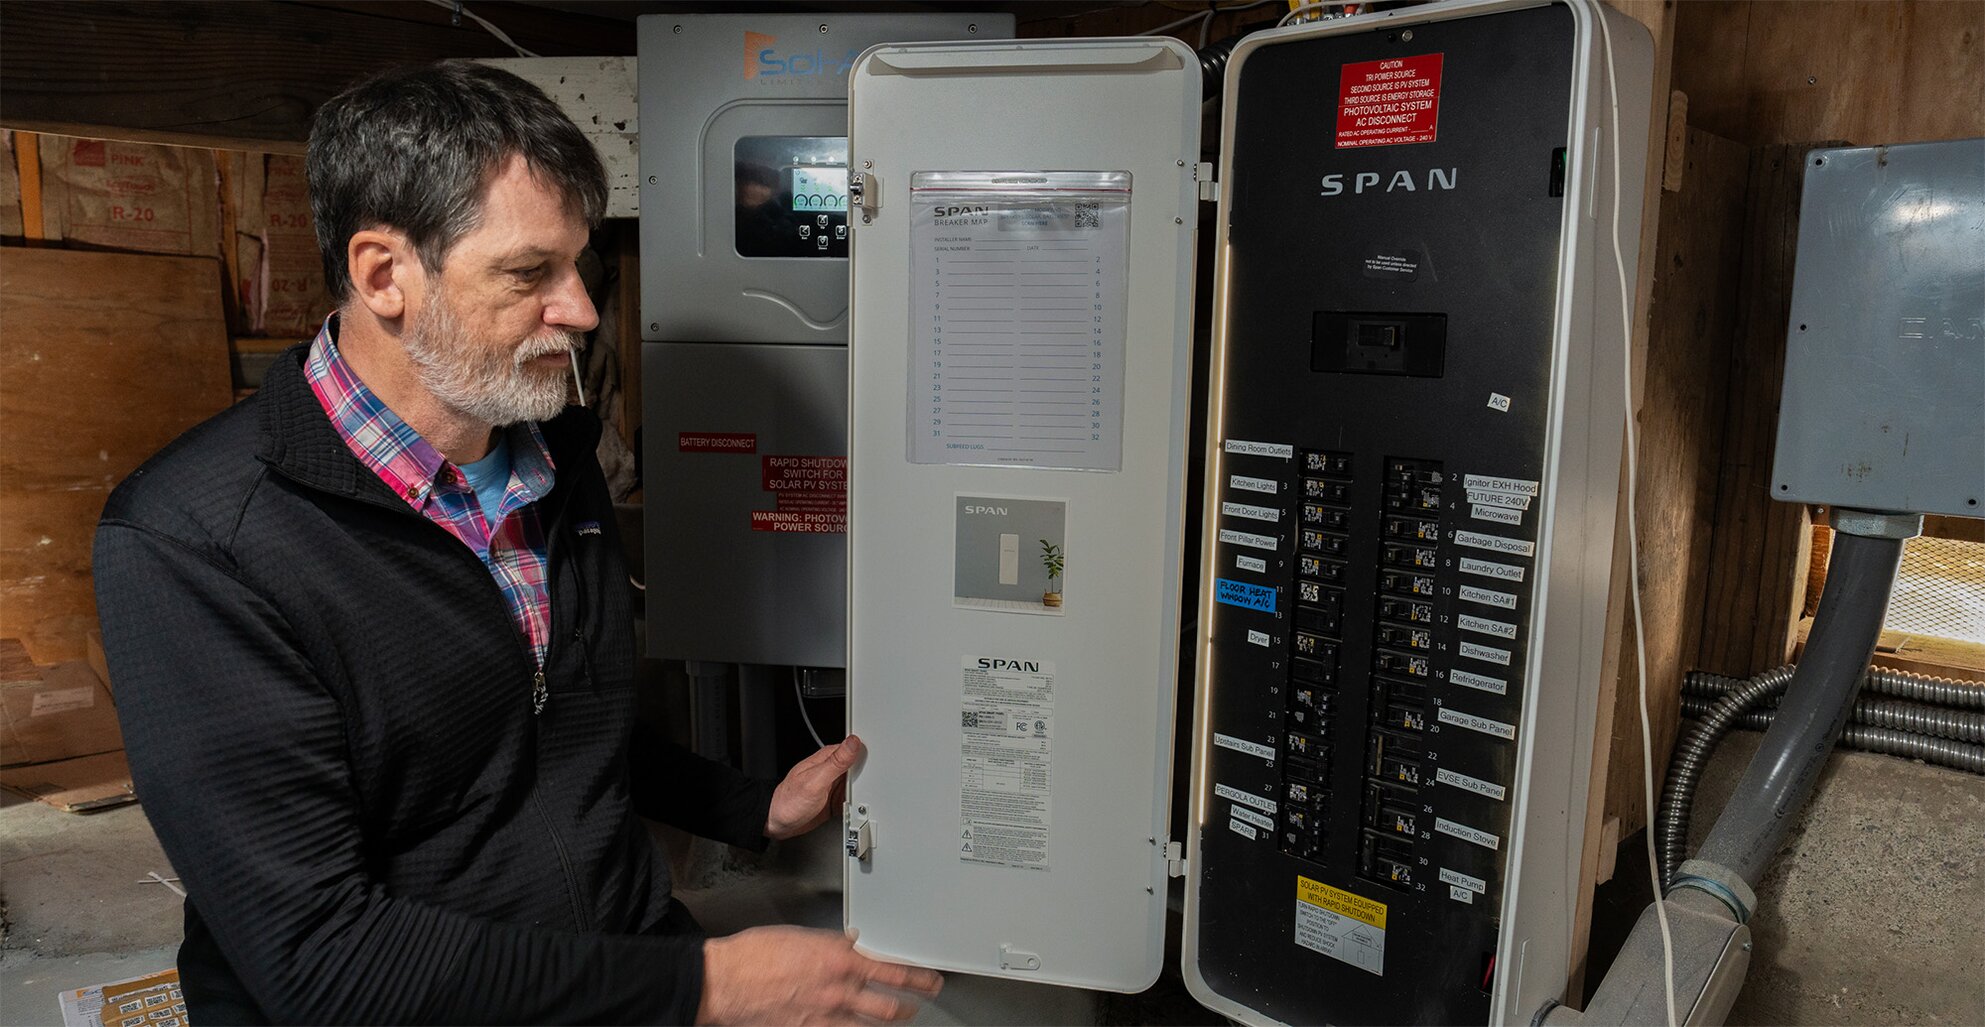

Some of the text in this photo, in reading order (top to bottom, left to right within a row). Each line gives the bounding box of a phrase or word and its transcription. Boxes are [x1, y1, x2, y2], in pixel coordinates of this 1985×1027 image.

[1380, 61, 1403, 70] CAUTION
[1366, 69, 1416, 82] TRI POWER SOURCE
[1351, 78, 1430, 94] SECOND SOURCE IS PV SYSTEM
[1344, 89, 1435, 105] THIRD SOURCE IS ENERGY STORAGE
[1344, 100, 1432, 116] PHOTOVOLTAIC SYSTEM
[1356, 112, 1417, 127] AC DISCONNECT
[1360, 128, 1385, 136] OPERATING
[1386, 126, 1408, 134] CURRENT
[111, 153, 145, 167] PINK
[1321, 167, 1457, 196] SPAN
[112, 206, 154, 222] R-20
[934, 206, 989, 217] SPAN
[270, 214, 307, 228] R-20
[1491, 396, 1508, 408] A/C
[680, 437, 755, 448] BATTERY DISCONNECT
[1226, 442, 1292, 456] Dining Room Outlets
[770, 458, 799, 467] RAPID
[783, 469, 843, 479] SWITCH FOR
[769, 480, 802, 489] SOLAR
[803, 480, 816, 489] PV
[1232, 479, 1276, 491] Kitchen Lights
[1283, 482, 1288, 490] 3
[1465, 478, 1536, 493] Ignitor EXH Hood
[1467, 491, 1527, 506] FUTURE 240V
[965, 505, 1008, 516] SPAN
[1450, 502, 1455, 510] 4
[752, 512, 802, 522] WARNING:
[1242, 507, 1258, 516] Door
[1258, 510, 1278, 519] Lights
[1475, 508, 1519, 521] Microwave
[773, 522, 812, 532] POWER
[1221, 532, 1276, 547] Front Pillar Power
[1280, 534, 1285, 542] 7
[1458, 534, 1531, 553] Garbage Disposal
[1239, 559, 1264, 570] Furnace
[1279, 560, 1283, 568] 9
[1446, 559, 1451, 567] 8
[1461, 561, 1521, 578] Laundry Outlet
[1220, 581, 1273, 600] FLOOR HEAT
[1442, 587, 1451, 595] 10
[1220, 592, 1270, 608] WINDOW A/C
[1461, 588, 1514, 606] Kitchen SA#1
[1275, 611, 1282, 619] 13
[1440, 615, 1448, 623] 12
[1460, 618, 1514, 636] Kitchen SA#2
[1250, 633, 1267, 644] Dryer
[1273, 636, 1280, 645] 15
[1437, 643, 1446, 651] 14
[1462, 645, 1508, 662] Dishwasher
[978, 658, 1039, 672] SPAN
[1435, 670, 1444, 678] 16
[1452, 672, 1504, 691] Refridgerator
[1270, 686, 1278, 694] 19
[1433, 698, 1442, 706] 18
[1268, 711, 1276, 719] 21
[1430, 724, 1440, 733] 20
[1440, 711, 1512, 736] Garage Sub Panel
[1267, 735, 1275, 744] 23
[1216, 736, 1274, 757] Upstairs Sub Panel
[1428, 751, 1437, 760] 22
[1266, 760, 1274, 768] 25
[1425, 778, 1435, 786] 24
[1438, 771, 1504, 796] EVSE Sub Panel
[1264, 784, 1272, 792] 27
[1216, 786, 1276, 812] PERGOLA OUTLET
[1423, 805, 1433, 813] 26
[1232, 807, 1272, 828] Water Heater
[1231, 822, 1255, 837] SPARE
[1436, 821, 1496, 846] Induction Stove
[1421, 831, 1430, 840] 28
[1418, 857, 1428, 865] 30
[1441, 871, 1484, 890] Heat Pump
[1416, 883, 1426, 891] 32
[1300, 880, 1384, 915] SOLAR PV SYSTEM EQUIPPED
[1454, 890, 1468, 900] A/C
[1308, 892, 1376, 922] WITH RAPID SHUTDOWN
